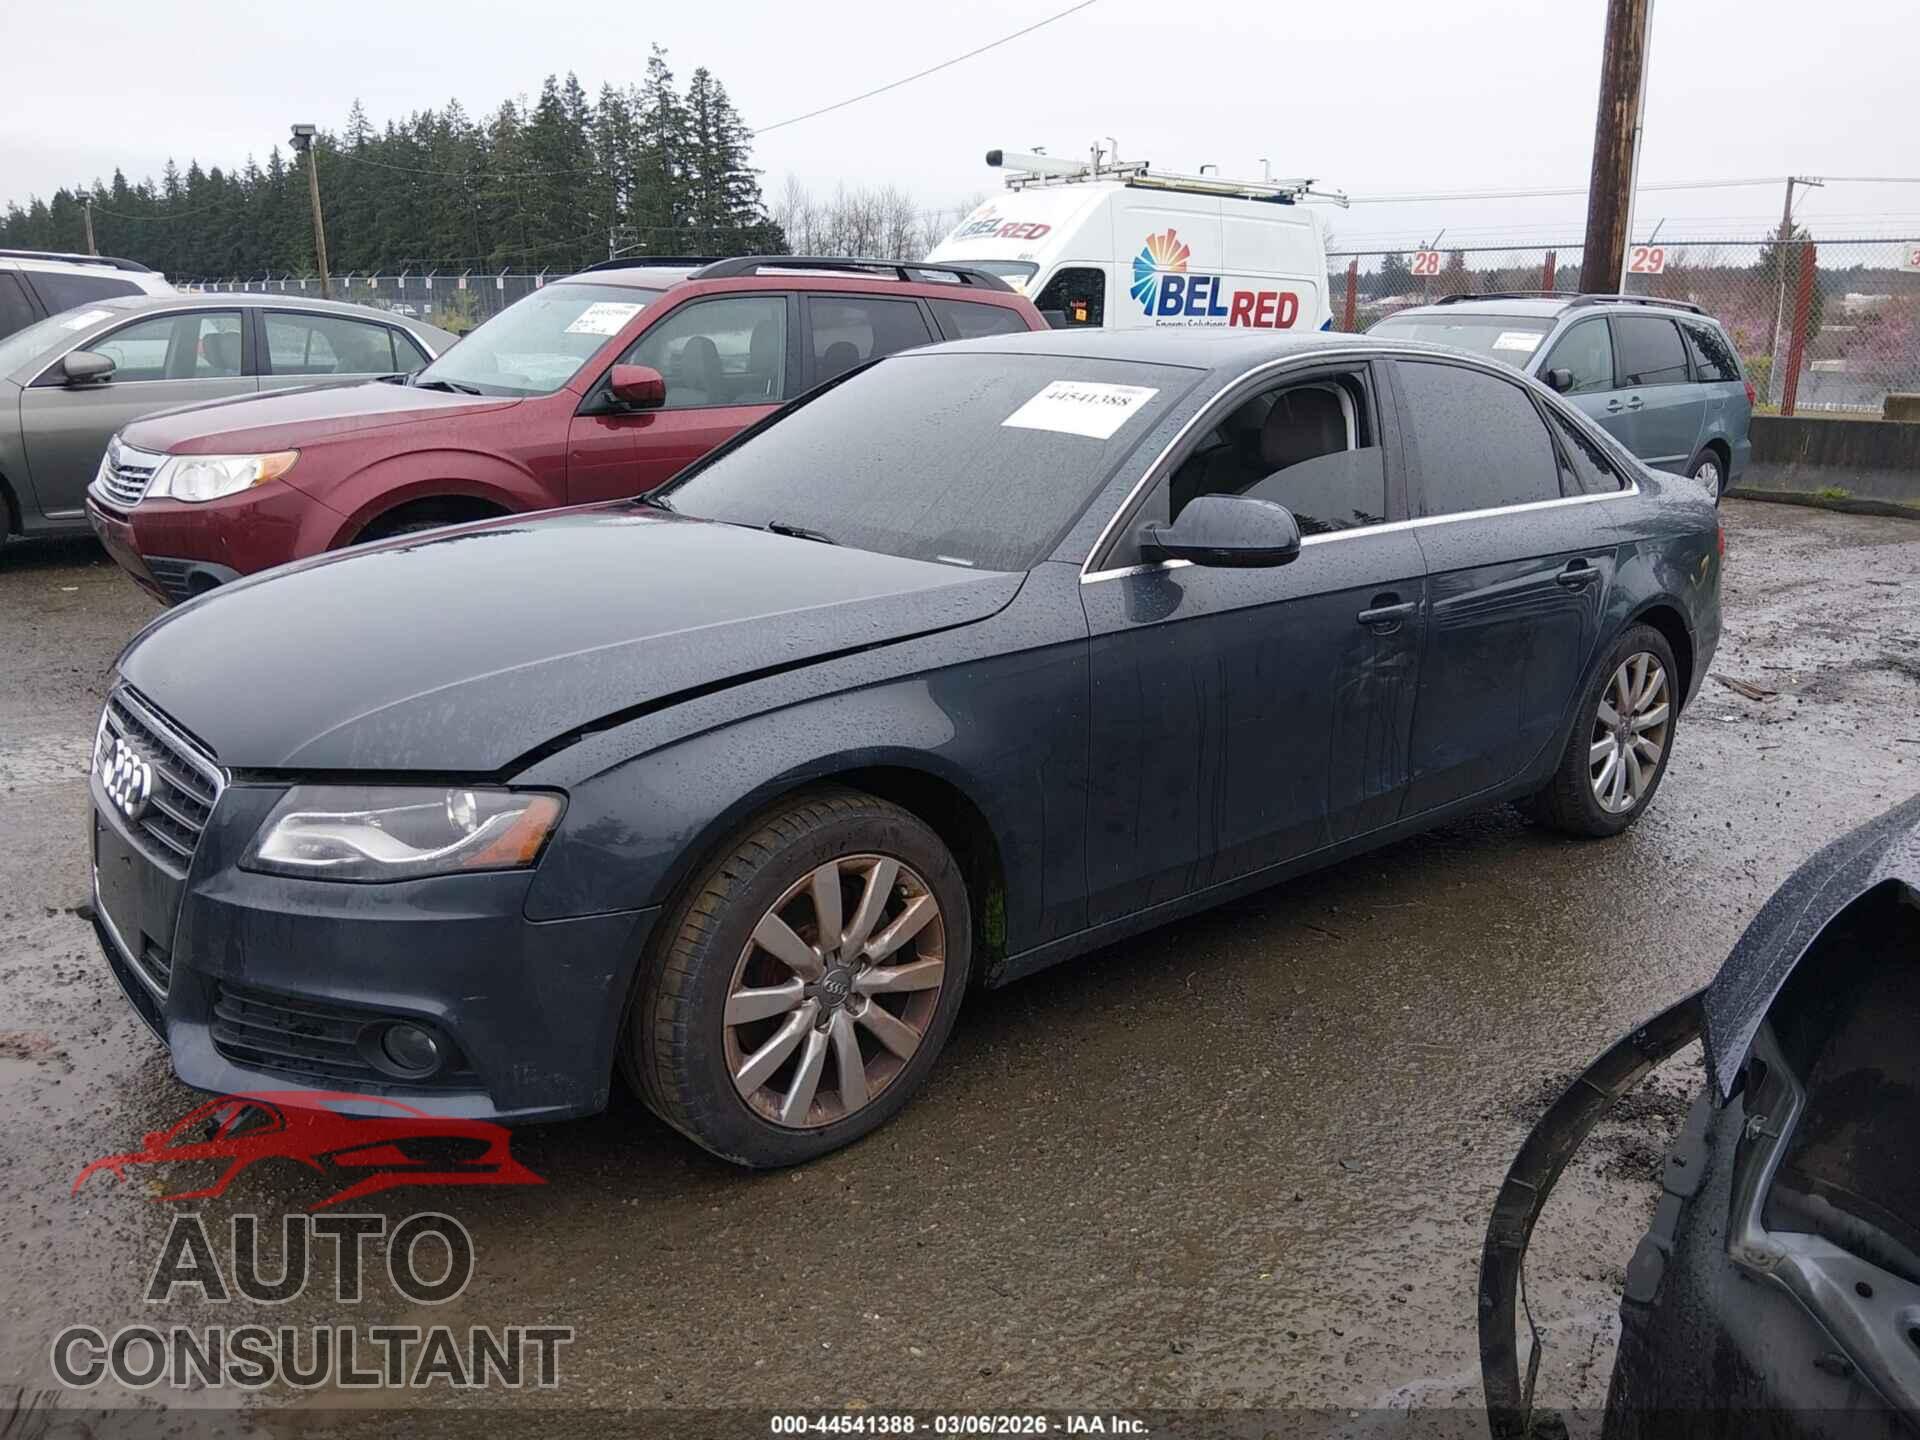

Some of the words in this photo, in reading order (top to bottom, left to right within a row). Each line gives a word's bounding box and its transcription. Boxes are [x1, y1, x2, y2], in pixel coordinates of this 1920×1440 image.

[1413, 252, 1439, 274] 28
[1631, 247, 1664, 272] 29
[1047, 391, 1132, 406] 44541388
